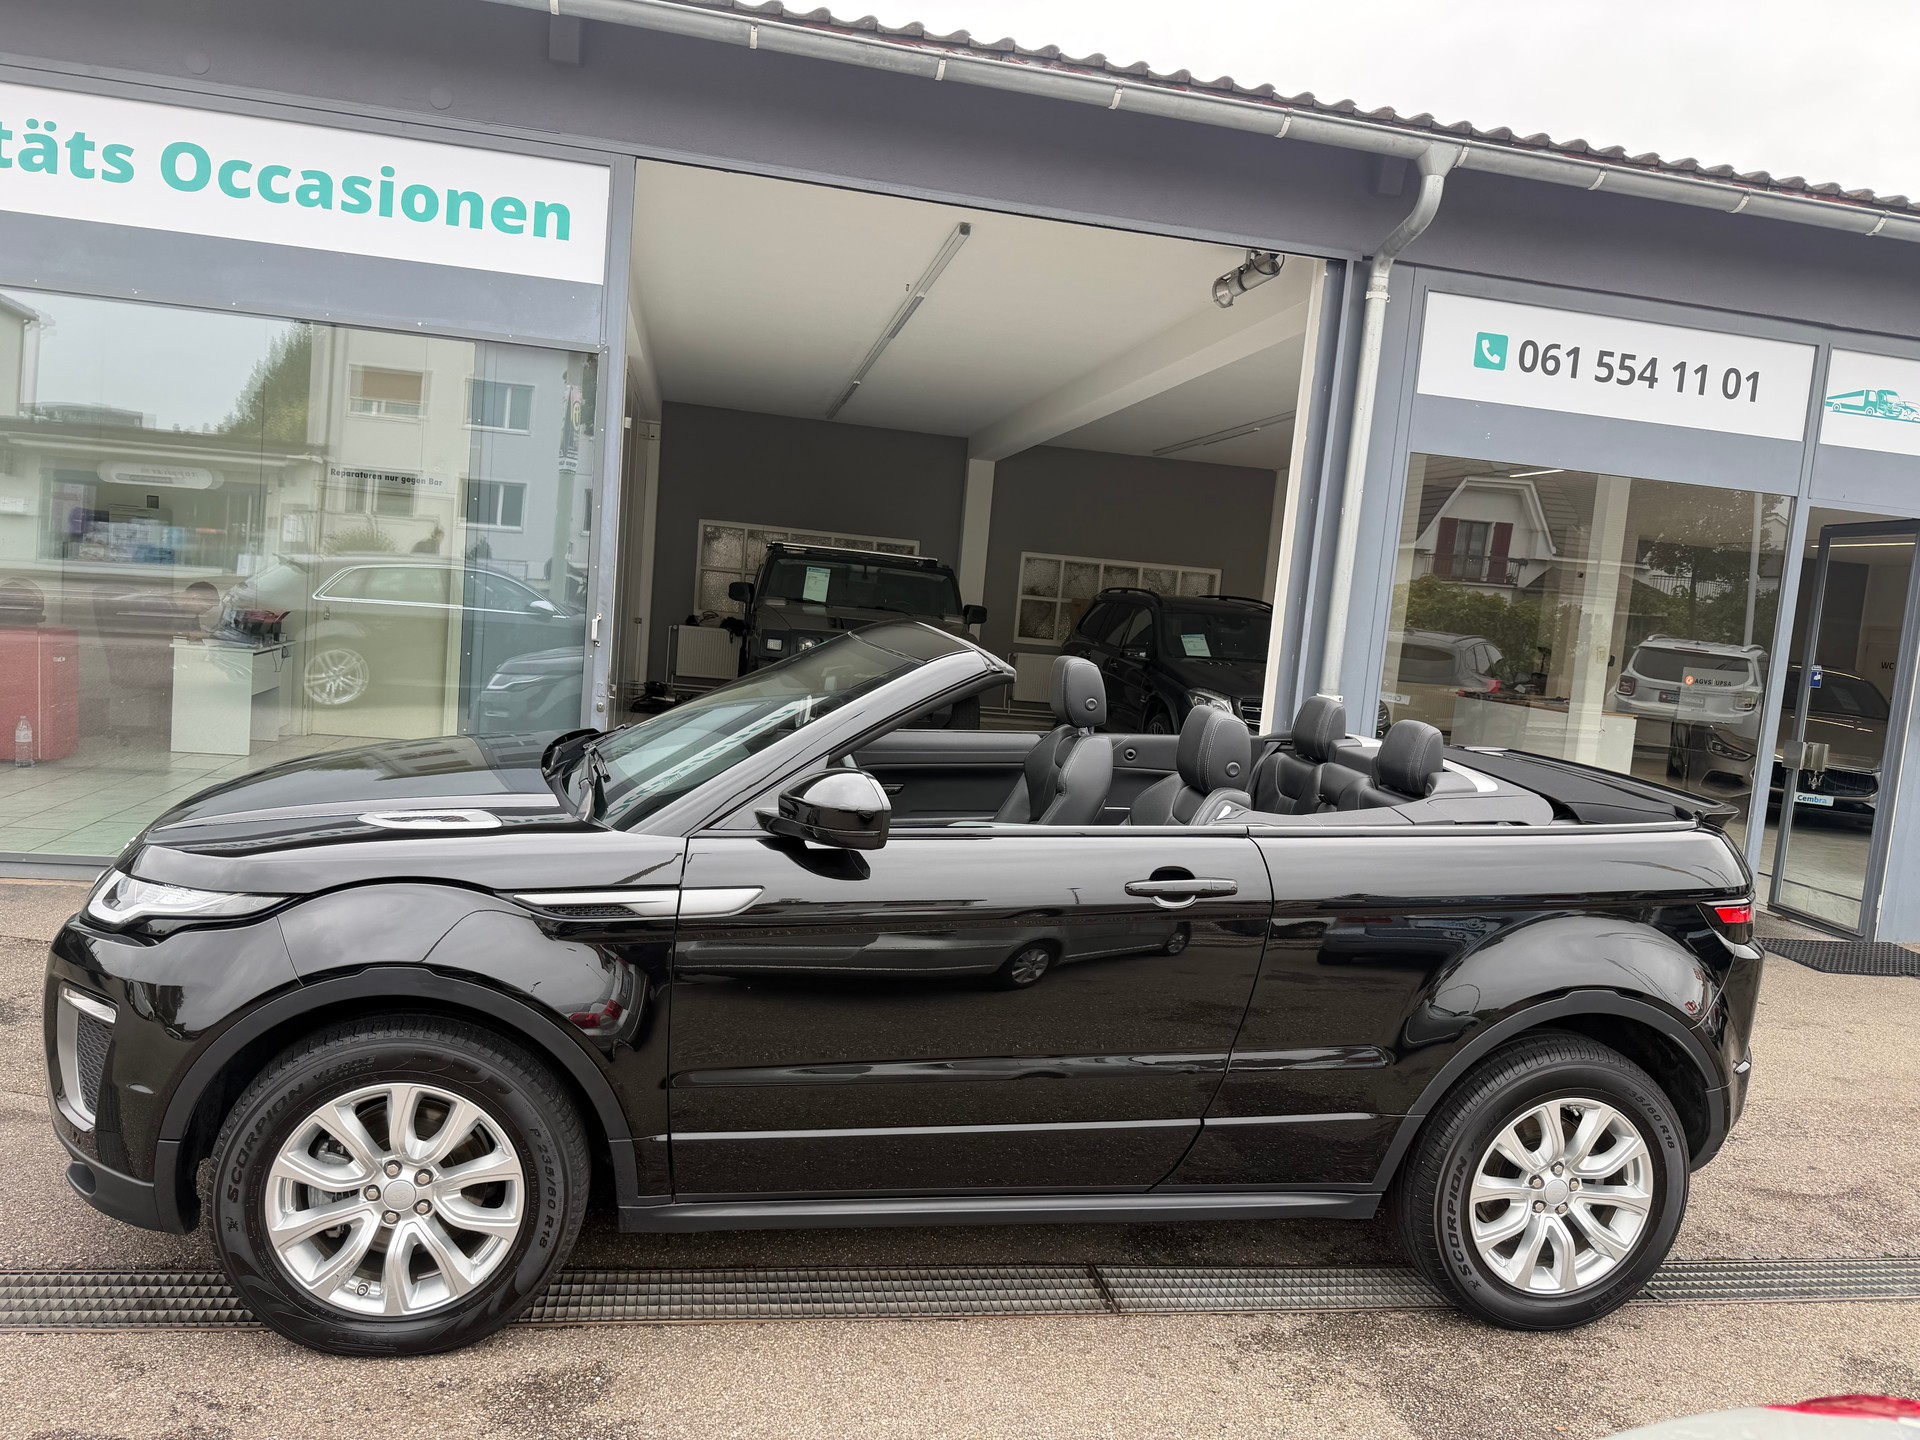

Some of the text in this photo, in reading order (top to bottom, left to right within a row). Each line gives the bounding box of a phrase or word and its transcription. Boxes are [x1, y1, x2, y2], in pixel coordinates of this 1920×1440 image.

[160, 141, 571, 241] Occasionen
[1518, 339, 1761, 403] 061 554 11 01
[330, 468, 382, 479] Reparaturen
[384, 474, 399, 482] nur
[428, 478, 443, 486] Bar
[1881, 662, 1895, 670] WC
[1797, 794, 1828, 804] Cembra
[227, 1082, 304, 1203] SCORPION
[537, 1142, 557, 1211] 235/60
[1445, 1154, 1473, 1277] SCORPION
